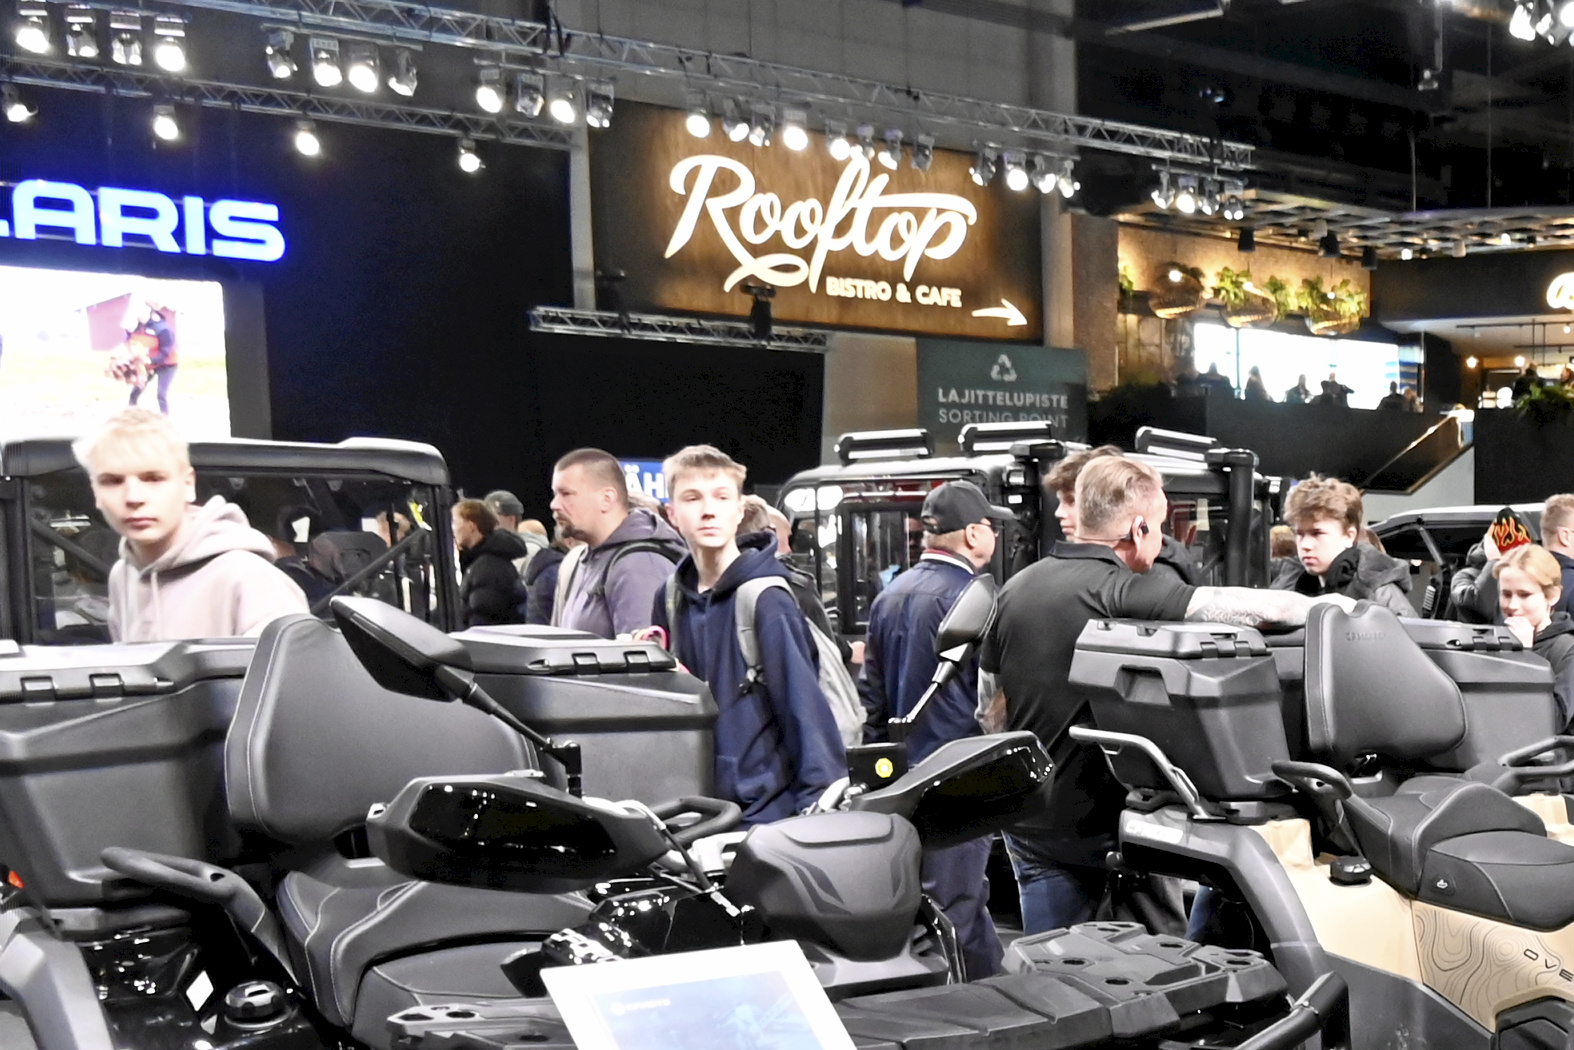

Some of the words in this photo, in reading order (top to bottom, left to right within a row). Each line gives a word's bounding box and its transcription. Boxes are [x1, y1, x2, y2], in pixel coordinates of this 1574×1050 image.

[0, 179, 287, 262] ARIS
[664, 146, 978, 294] Rooftop
[825, 276, 891, 302] BISTRO
[896, 282, 912, 303] &
[917, 284, 963, 308] CAFE
[937, 387, 1069, 409] LAJITTELUPISTE
[938, 407, 1014, 424] SORTING
[625, 463, 669, 500] ÄH
